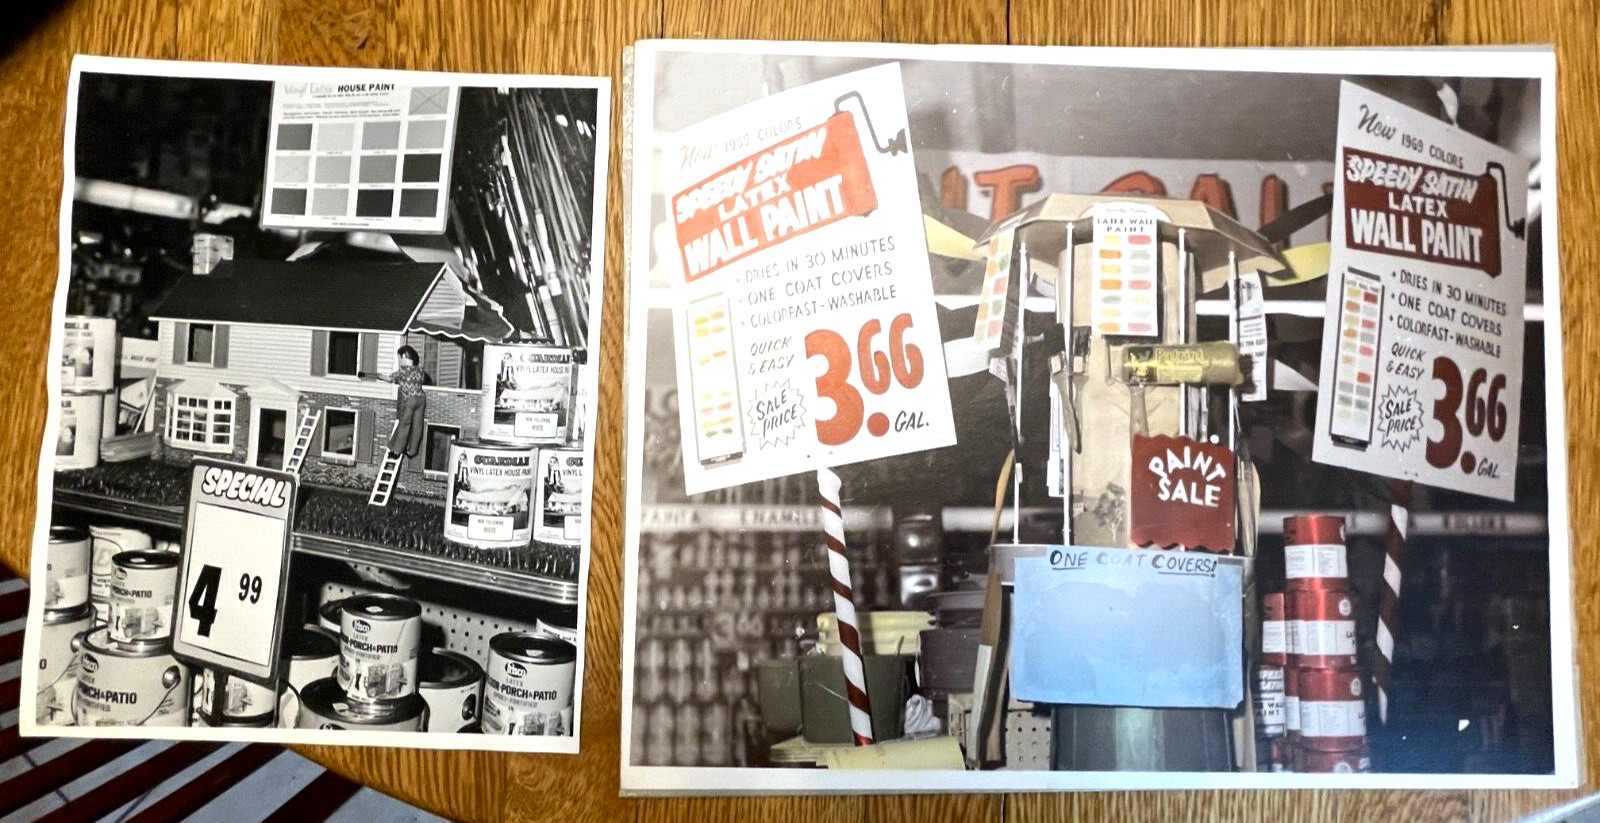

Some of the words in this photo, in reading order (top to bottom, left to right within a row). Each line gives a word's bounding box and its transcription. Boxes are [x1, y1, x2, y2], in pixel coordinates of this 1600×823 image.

[337, 83, 367, 93] HOUSE
[368, 83, 395, 92] PAINT
[680, 144, 718, 171] New
[725, 136, 750, 153] 1969
[757, 116, 802, 141] COLORS
[1358, 104, 1396, 141] New
[1401, 133, 1424, 153] 1969
[1429, 145, 1464, 170] COLORS
[676, 159, 753, 223] SPEEDY
[753, 127, 827, 184] SATIN
[1346, 154, 1423, 193] SPEEDY
[1421, 170, 1478, 204] SATIN
[718, 173, 791, 222] LATEX
[1388, 191, 1448, 218] LATEX
[684, 216, 758, 277] WALL
[760, 173, 846, 243] PAINT
[1350, 208, 1416, 253] WALL
[1421, 218, 1483, 263] PAINT
[745, 262, 780, 284] DRIES
[786, 258, 799, 273] IN
[806, 253, 826, 269] 30
[832, 236, 896, 262] MINUTES
[748, 287, 775, 306] ONE
[785, 276, 823, 298] COAT
[831, 261, 893, 287] COVERS
[1400, 269, 1428, 291] DRIES
[1432, 279, 1442, 294] IN
[1446, 285, 1462, 301] 30
[1465, 292, 1507, 317] MINUTES
[1398, 292, 1421, 312] ONE
[1428, 301, 1456, 323] COAT
[1461, 312, 1502, 337] COVERS
[750, 336, 793, 357] QUICK
[1391, 342, 1426, 363] QUICK
[532, 366, 549, 374] LATEX
[759, 354, 795, 374] EASY
[1395, 362, 1424, 381] EASY
[755, 389, 788, 421] SALE
[762, 403, 798, 438] PRICE
[894, 410, 930, 432] GAL.
[1385, 400, 1412, 419] SALE
[1387, 415, 1417, 437] PRICE
[470, 467, 485, 476] VINYL
[485, 467, 503, 477] LATEX
[504, 468, 521, 477] HOUSE
[563, 468, 577, 477] VINYL
[1149, 446, 1226, 481] PAINT
[201, 467, 286, 508] SPECIAL
[1157, 476, 1221, 508] SALE
[1050, 550, 1088, 567] ONE
[1096, 552, 1149, 568] COAT
[1152, 553, 1219, 578] COVERS!
[188, 563, 222, 638] 4
[238, 573, 262, 604] 99
